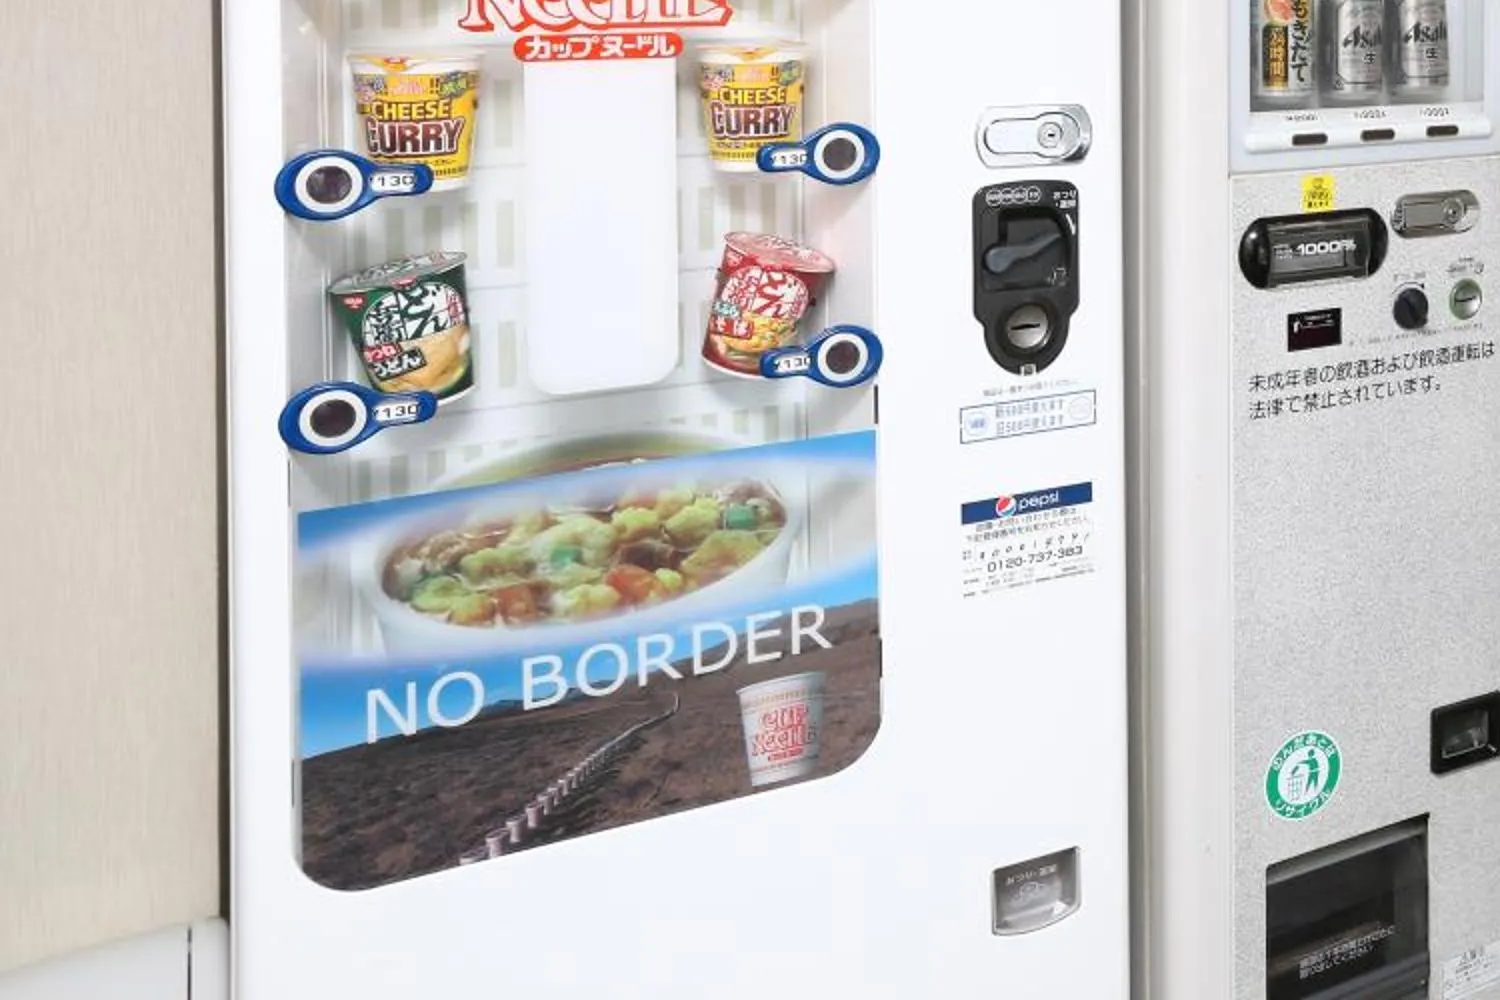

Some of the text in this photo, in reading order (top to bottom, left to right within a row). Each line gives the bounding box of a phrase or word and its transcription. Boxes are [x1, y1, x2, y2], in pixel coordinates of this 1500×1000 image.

[524, 34, 677, 60] カップヌードル
[371, 99, 450, 121] CHEESE
[719, 86, 787, 105] CHEESE
[366, 116, 466, 156] CURRY
[711, 100, 797, 139] CURRY
[1249, 341, 1495, 393] 未成年者の飲酒および飲酒運転は
[1018, 491, 1060, 511] pepsi
[522, 604, 832, 711] BORDER
[366, 672, 485, 743] NO
